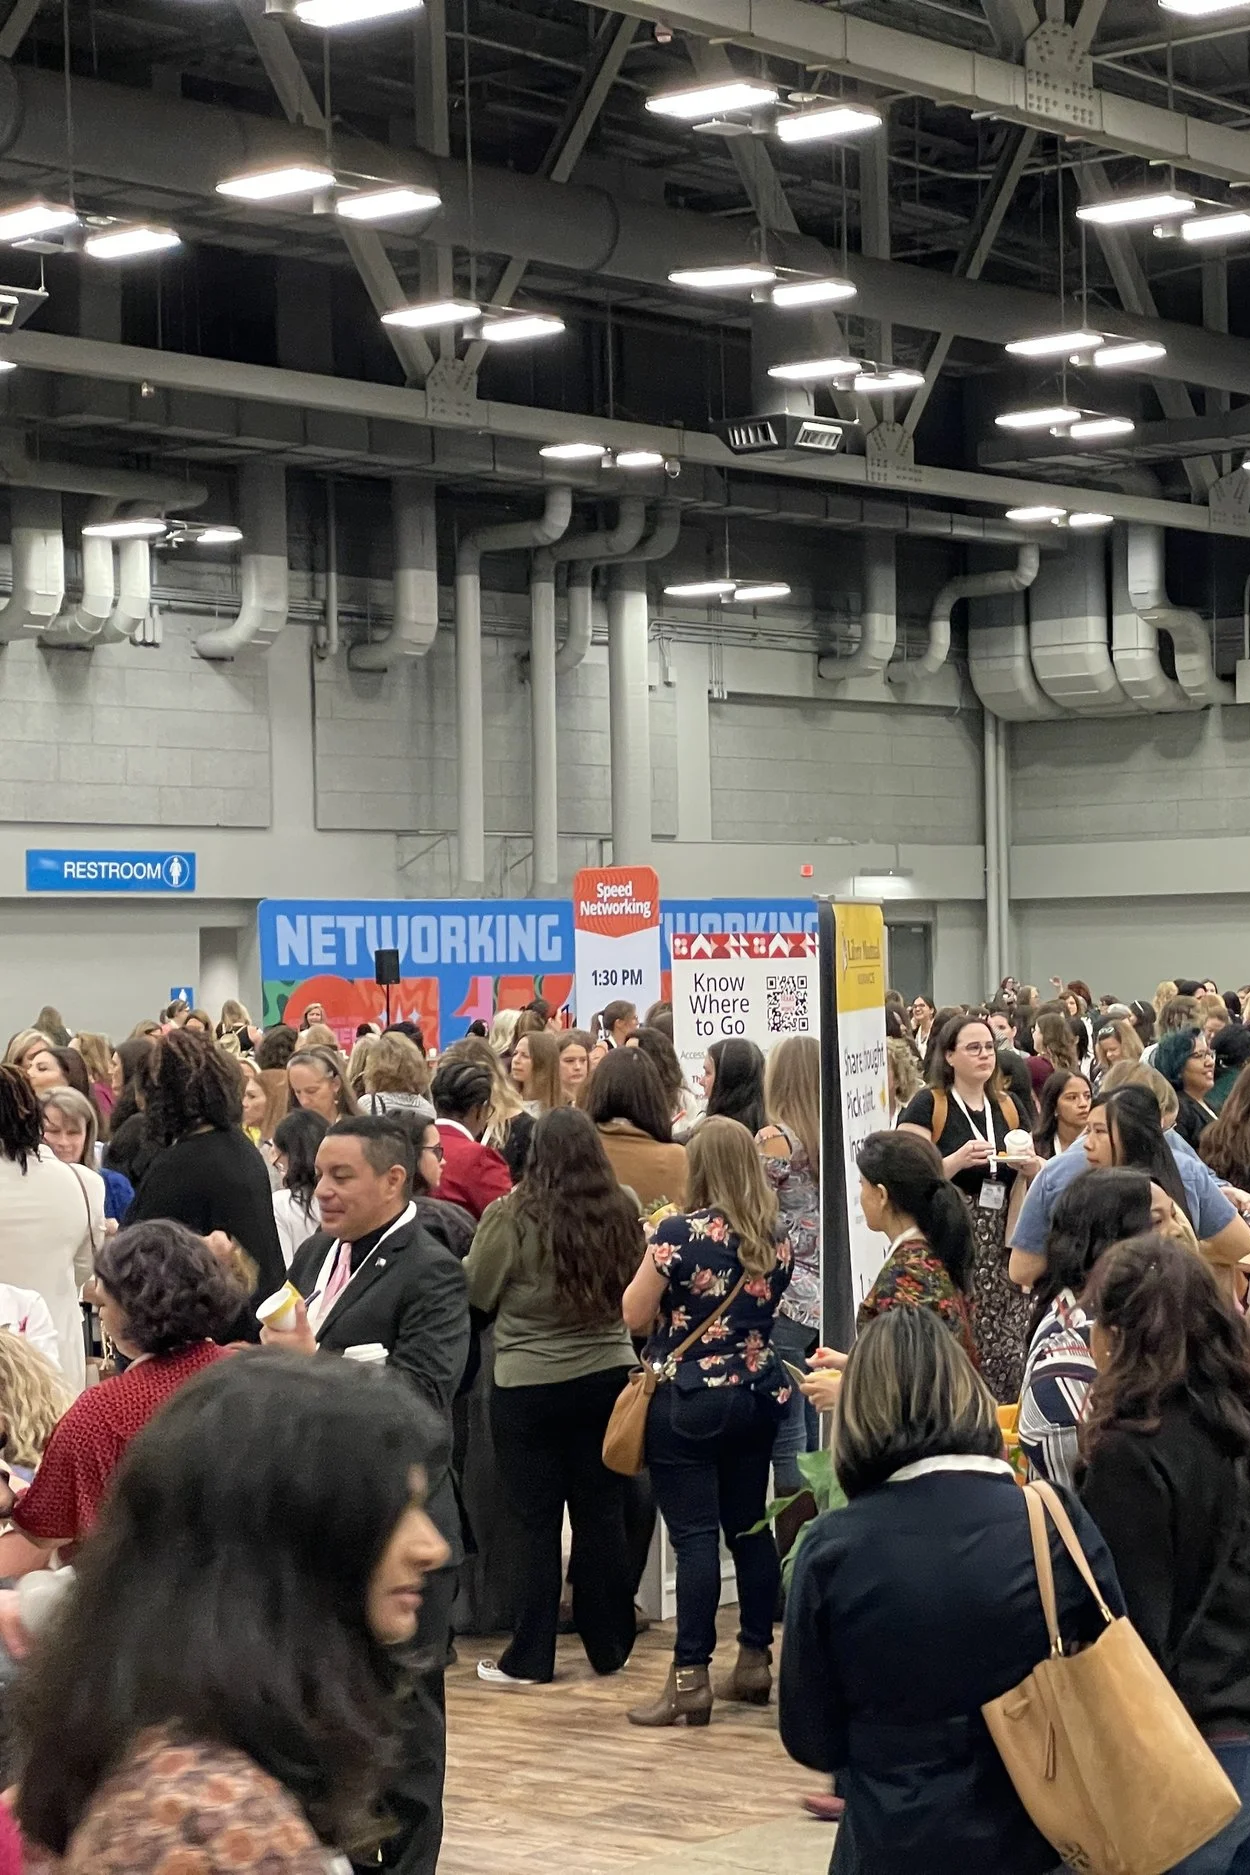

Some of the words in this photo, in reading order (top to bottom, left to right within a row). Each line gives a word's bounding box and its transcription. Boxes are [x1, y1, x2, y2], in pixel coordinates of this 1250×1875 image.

[63, 861, 162, 880] RESTROOM
[596, 881, 633, 900] Speed
[580, 899, 652, 919] Networking
[276, 914, 562, 967] NETWORKING
[591, 969, 618, 986] 1:30
[622, 968, 643, 986] PM
[694, 973, 745, 992] Know
[689, 995, 750, 1014] Where
[696, 1017, 712, 1035] to
[721, 1016, 745, 1035] Go
